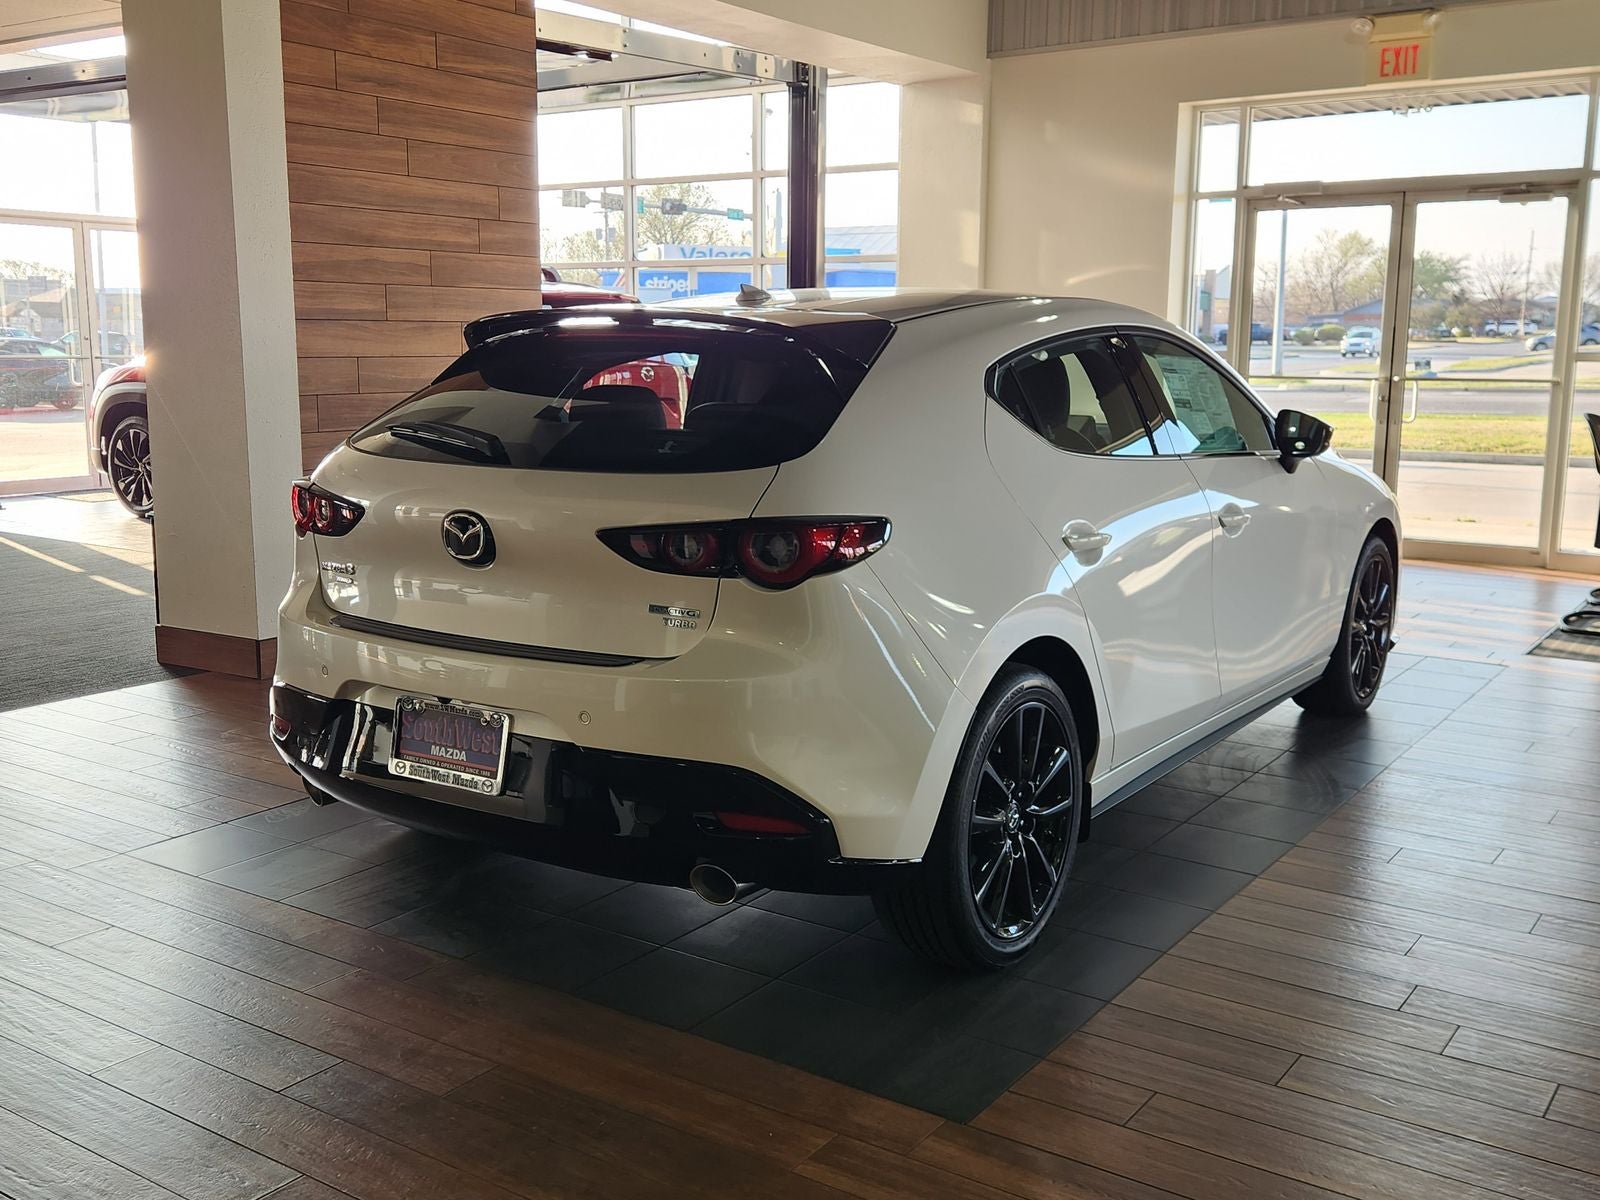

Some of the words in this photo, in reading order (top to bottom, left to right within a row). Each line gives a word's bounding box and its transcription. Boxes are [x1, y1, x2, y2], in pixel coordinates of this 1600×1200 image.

[1379, 44, 1421, 77] EXIT
[680, 246, 751, 259] Valero
[663, 617, 697, 629] TURBO
[430, 745, 467, 761] MAZDA
[452, 773, 479, 790] Mazda
